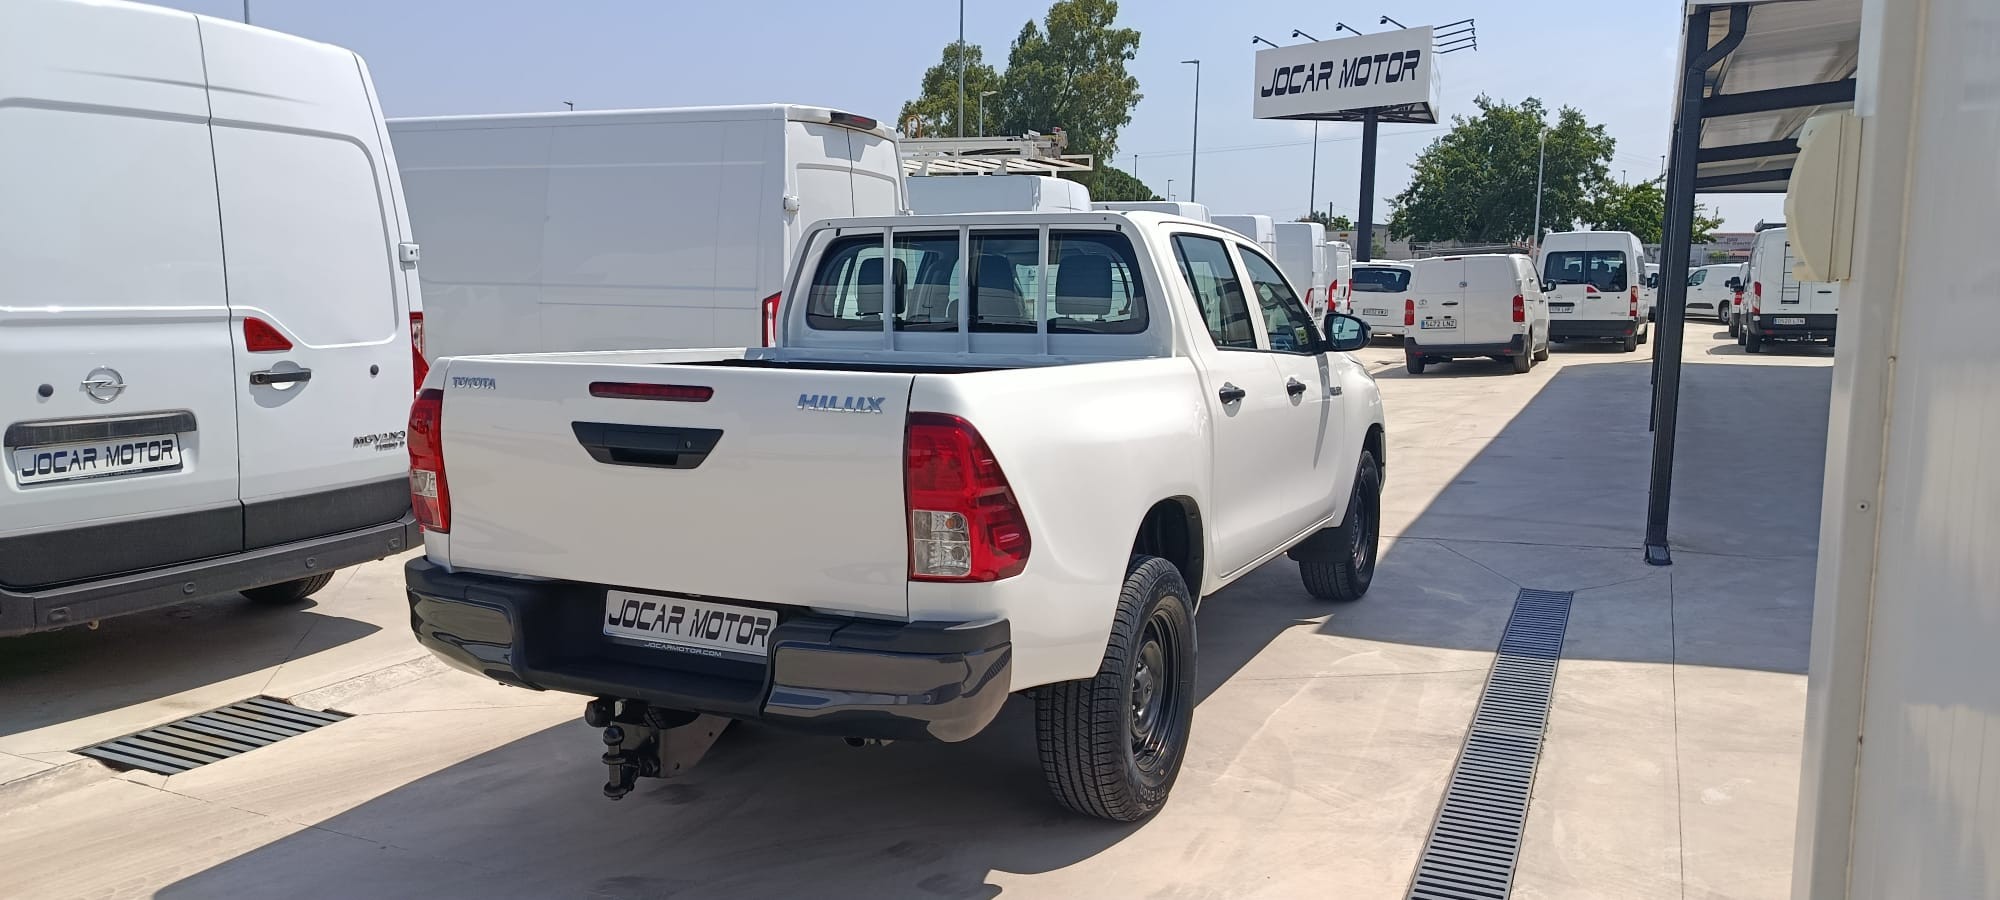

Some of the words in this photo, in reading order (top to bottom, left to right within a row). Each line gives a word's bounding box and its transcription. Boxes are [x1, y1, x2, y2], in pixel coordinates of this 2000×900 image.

[1261, 61, 1333, 98] JOCAR
[1338, 49, 1421, 89] MOTOR
[452, 376, 496, 390] TOYOTA
[797, 394, 885, 413] HILUX
[21, 448, 98, 477] JOCAR
[106, 439, 174, 467] MOTOR
[608, 599, 686, 635] JOCAR
[689, 608, 772, 647] MOTOR
[644, 642, 722, 657] JOCARMOTOR.COM
